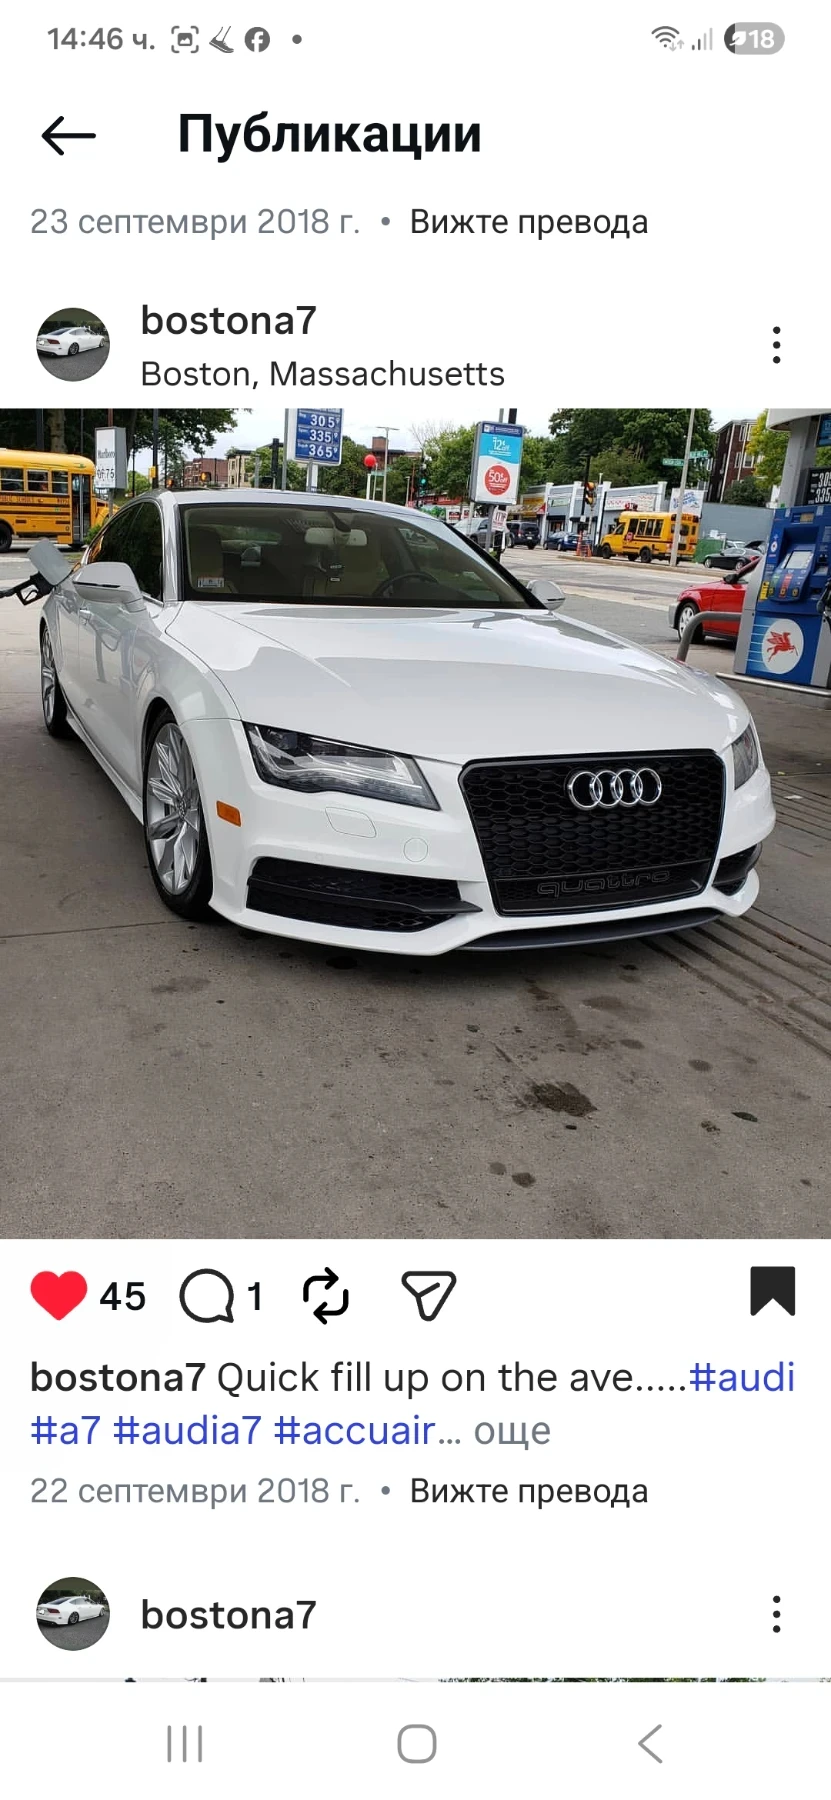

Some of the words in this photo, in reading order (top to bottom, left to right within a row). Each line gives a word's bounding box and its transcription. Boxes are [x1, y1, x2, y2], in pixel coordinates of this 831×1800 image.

[309, 429, 332, 443] 335
[308, 443, 333, 458] 365
[536, 870, 671, 898] quattro
